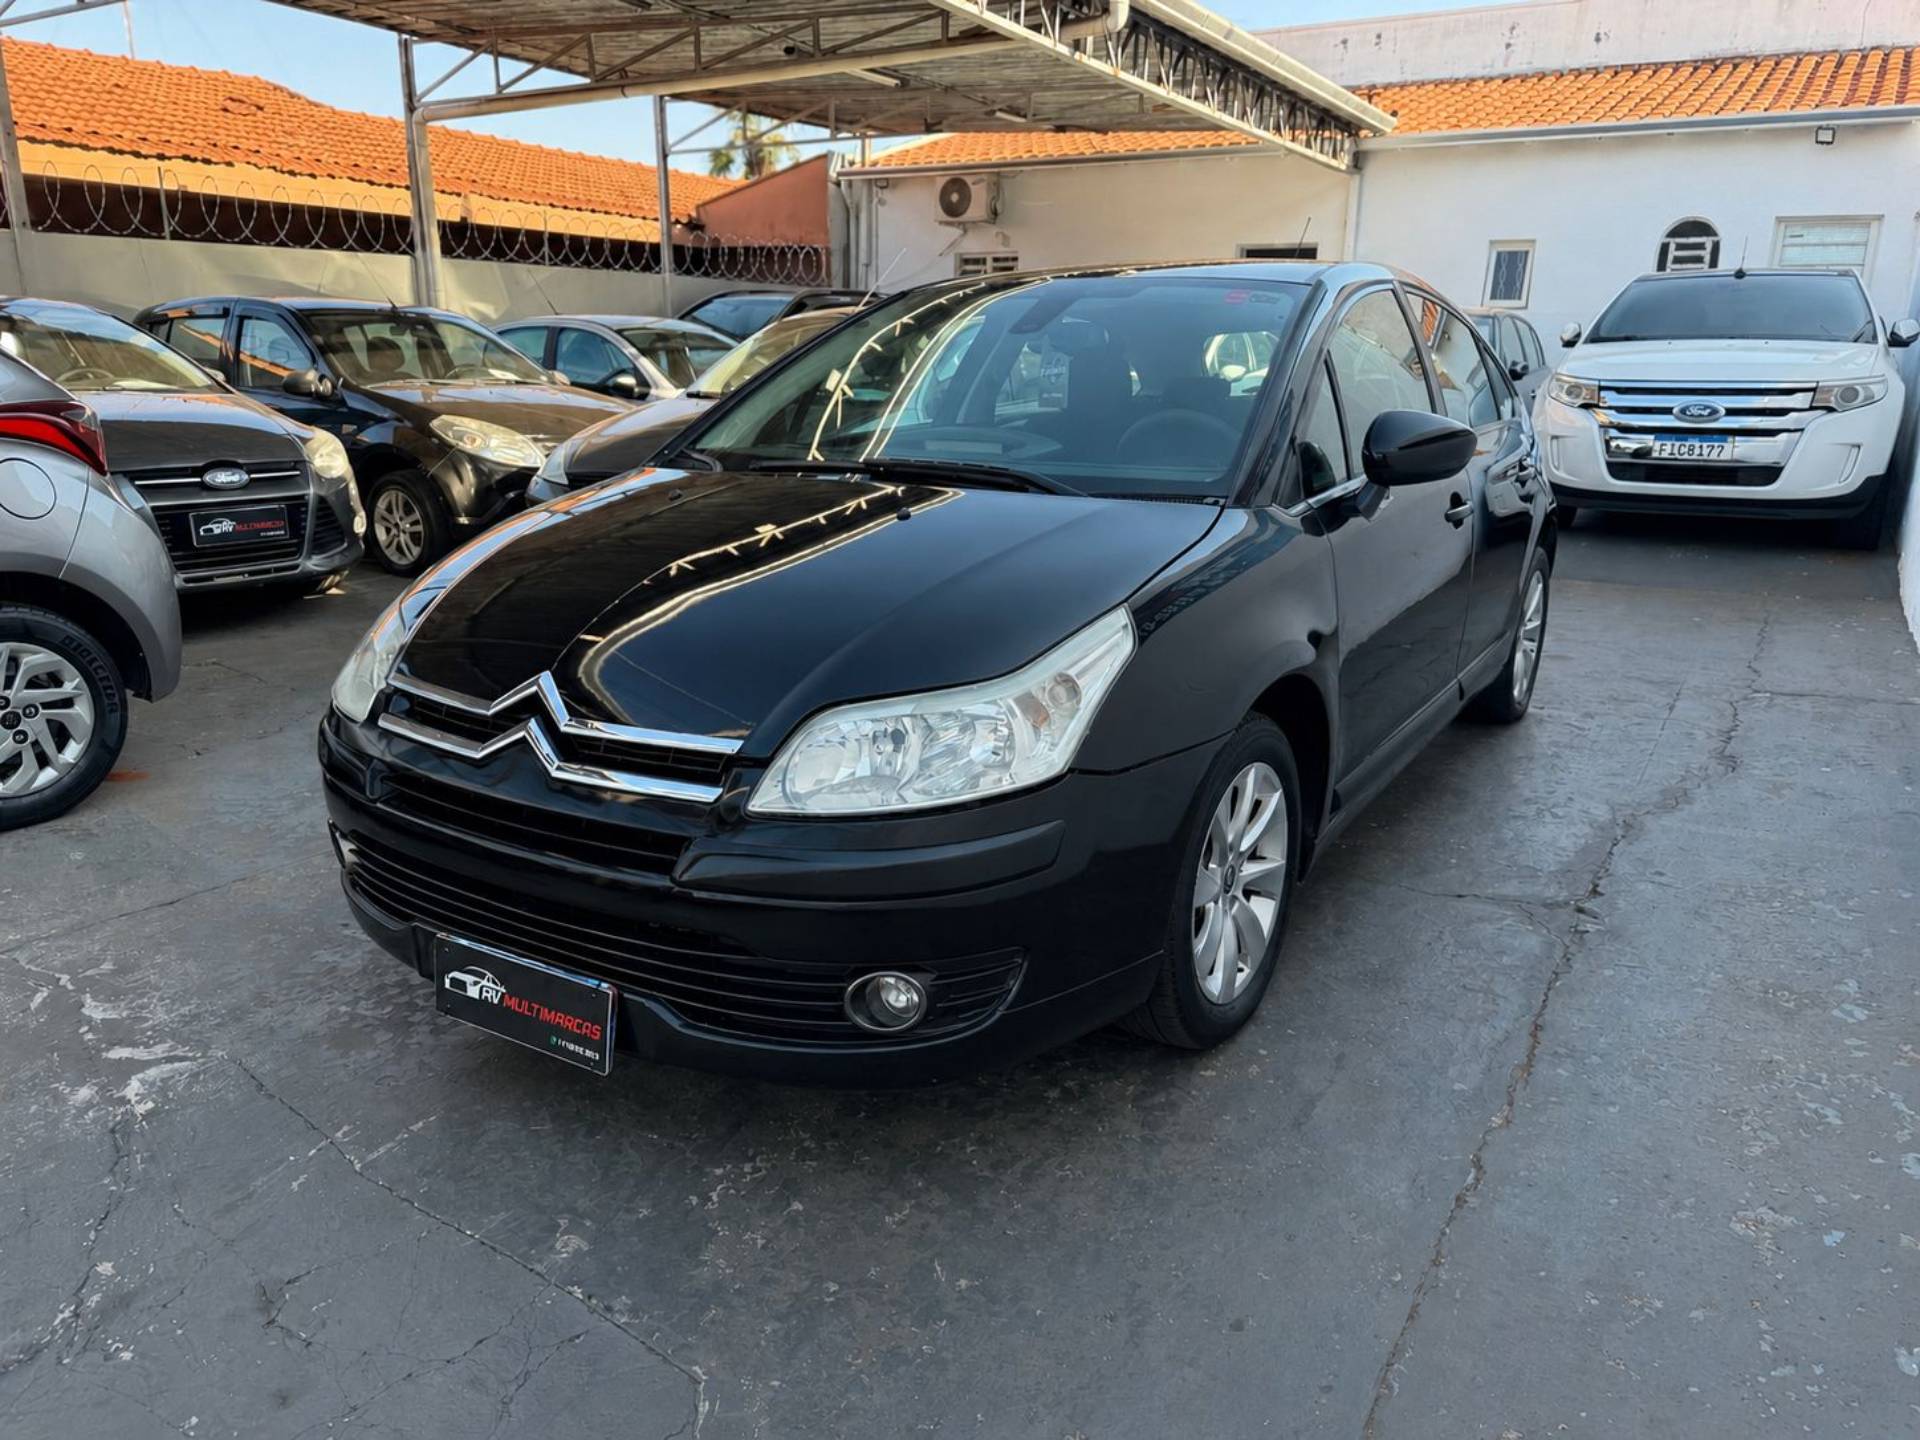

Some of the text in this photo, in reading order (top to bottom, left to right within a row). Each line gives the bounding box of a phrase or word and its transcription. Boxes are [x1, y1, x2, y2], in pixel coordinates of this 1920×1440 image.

[1685, 405, 1712, 417] Ford
[1658, 442, 1725, 458] FIC8177
[481, 986, 602, 1040] RV MULTIMARCAS
